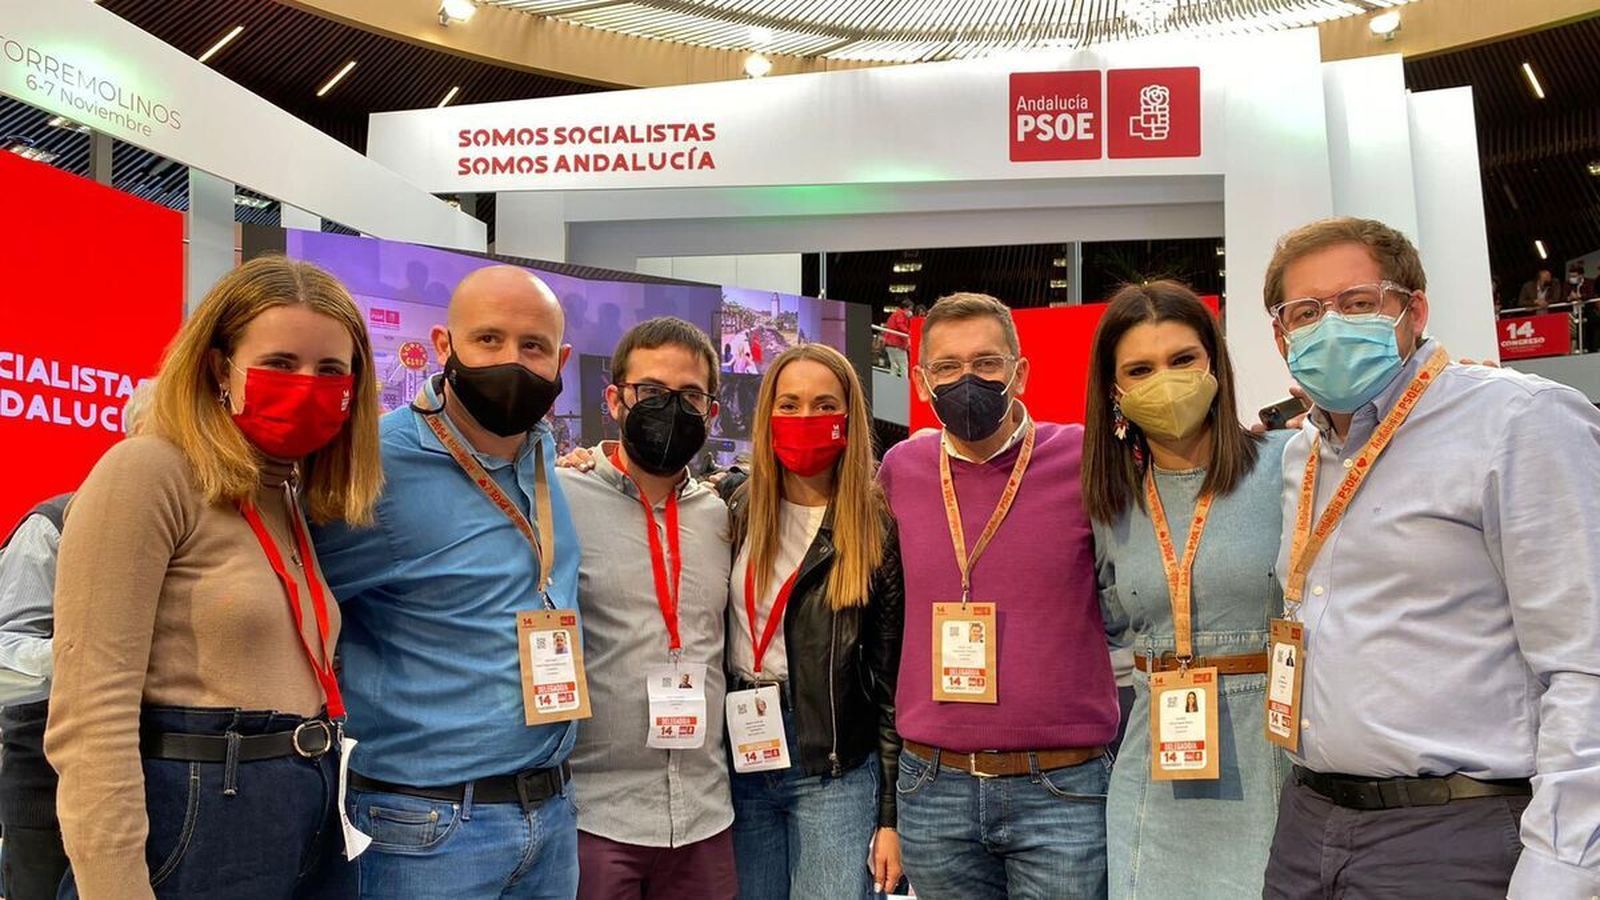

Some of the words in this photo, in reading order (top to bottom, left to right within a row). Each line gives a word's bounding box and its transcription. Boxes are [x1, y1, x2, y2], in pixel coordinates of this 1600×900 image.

[0, 35, 182, 130] ORREMOLINOS
[26, 74, 55, 97] 6-7
[60, 88, 153, 137] Noviembre
[1016, 93, 1089, 111] Andalucía
[458, 127, 549, 147] SOMOS
[553, 123, 716, 145] SOCIALISTAS
[1017, 112, 1094, 142] PSOE
[458, 155, 549, 176] SOMOS
[553, 146, 716, 173] ANDALUCÍA
[1506, 321, 1535, 339] 14
[949, 677, 961, 686] 14
[538, 695, 552, 706] 14
[661, 726, 672, 736] 14
[745, 751, 757, 762] 14
[1165, 752, 1177, 763] 14
